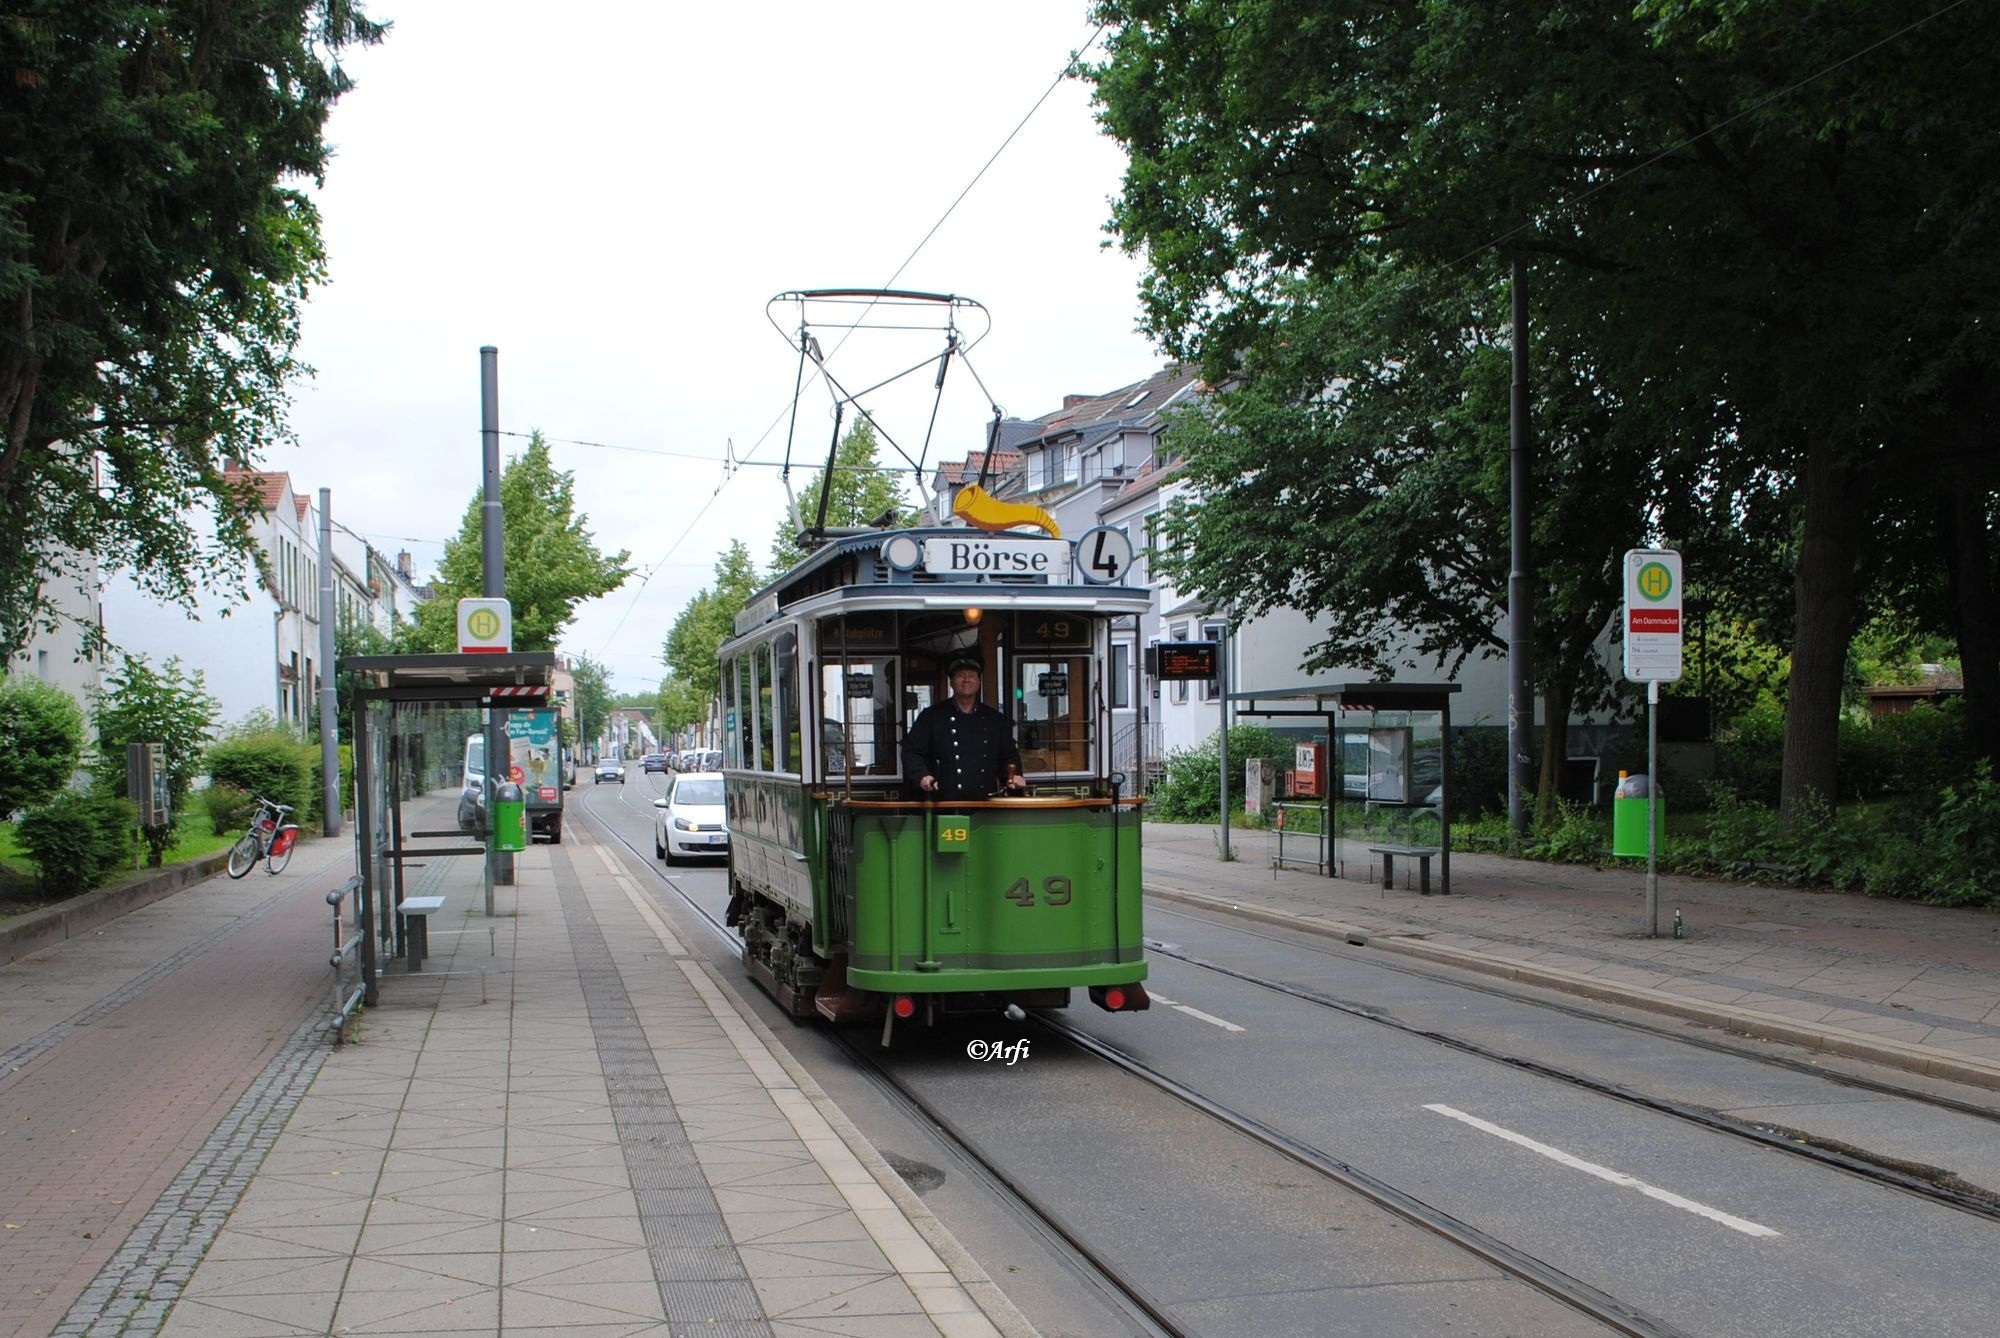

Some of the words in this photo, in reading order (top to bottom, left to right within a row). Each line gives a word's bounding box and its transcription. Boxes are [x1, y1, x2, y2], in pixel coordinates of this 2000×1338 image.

[949, 542, 1049, 572] Börse
[1092, 531, 1118, 578] 4
[1647, 570, 1662, 593] H
[476, 615, 491, 634] H
[1036, 622, 1070, 639] 49
[1632, 617, 1643, 625] Am
[1643, 616, 1678, 625] Dammacker
[941, 828, 968, 842] 49
[1004, 875, 1072, 908] 49
